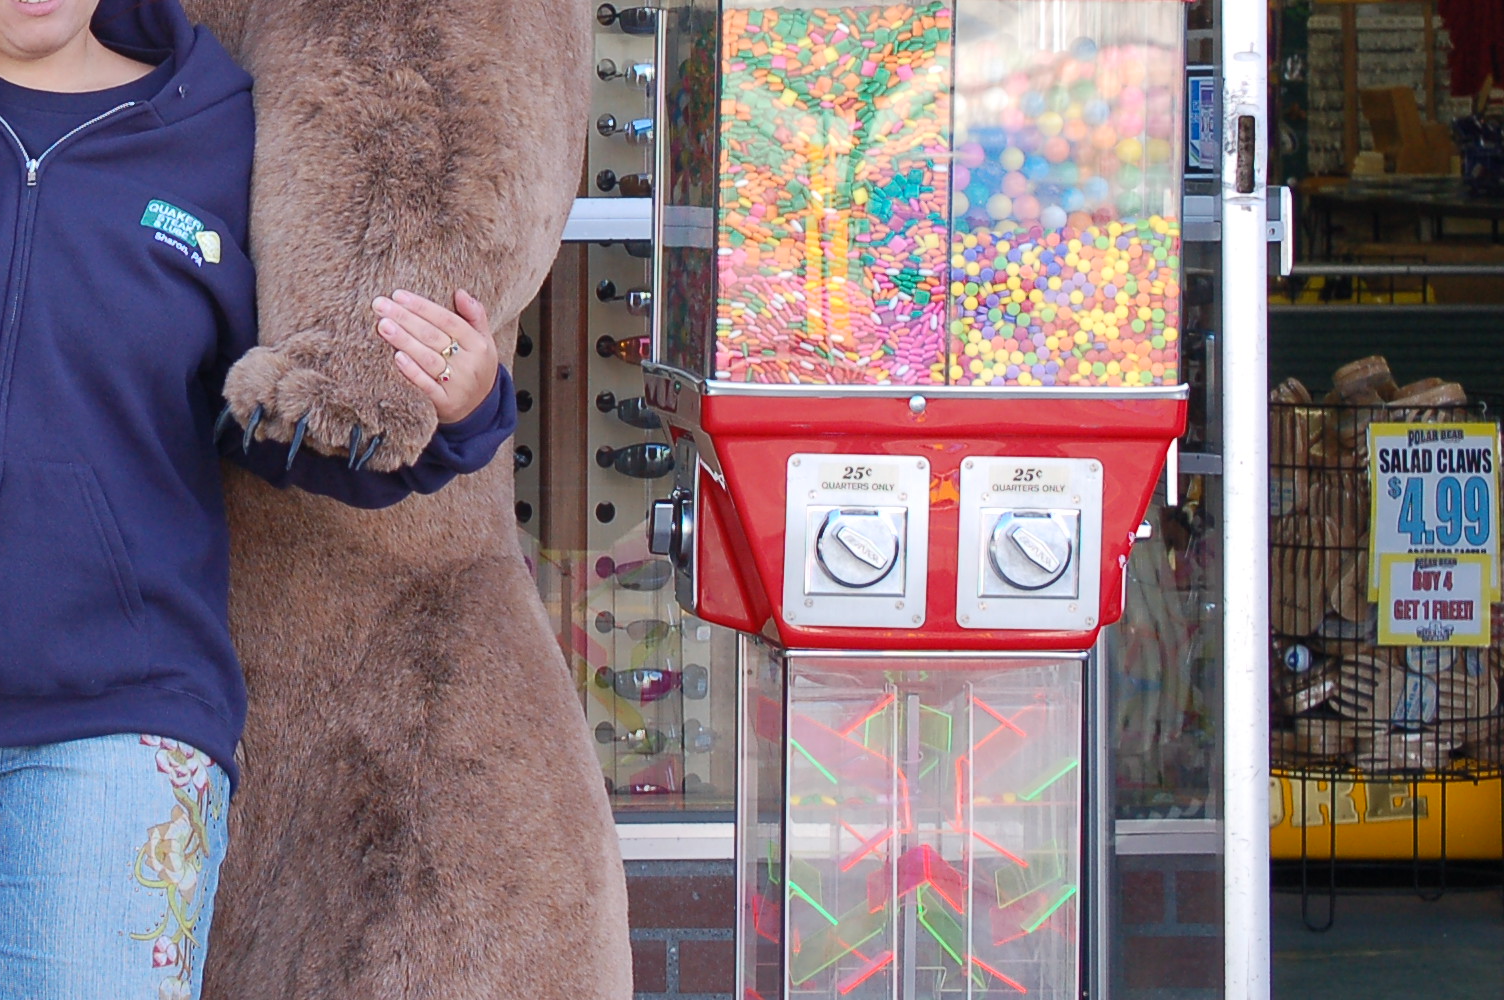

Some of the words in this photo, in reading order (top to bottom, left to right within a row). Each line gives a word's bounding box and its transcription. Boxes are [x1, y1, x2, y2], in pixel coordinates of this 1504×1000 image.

[148, 203, 204, 230] QUAKER
[156, 213, 194, 234] STEAK
[1408, 429, 1438, 447] POLAR
[1440, 428, 1464, 441] BEAR
[1379, 448, 1432, 473] SALAD
[1437, 448, 1492, 473] CLAWS
[842, 466, 872, 481] 25¢
[1013, 468, 1043, 482] 25¢
[821, 481, 869, 491] QUARTERS
[871, 482, 895, 492] ONLY
[992, 484, 1040, 493] QUARTERS
[1042, 484, 1066, 493] ONLY
[1388, 476, 1490, 546] $4.99
[1412, 571, 1441, 591] BUY
[1443, 570, 1453, 591] 4
[1394, 599, 1420, 621] GET
[1422, 600, 1429, 620] 1
